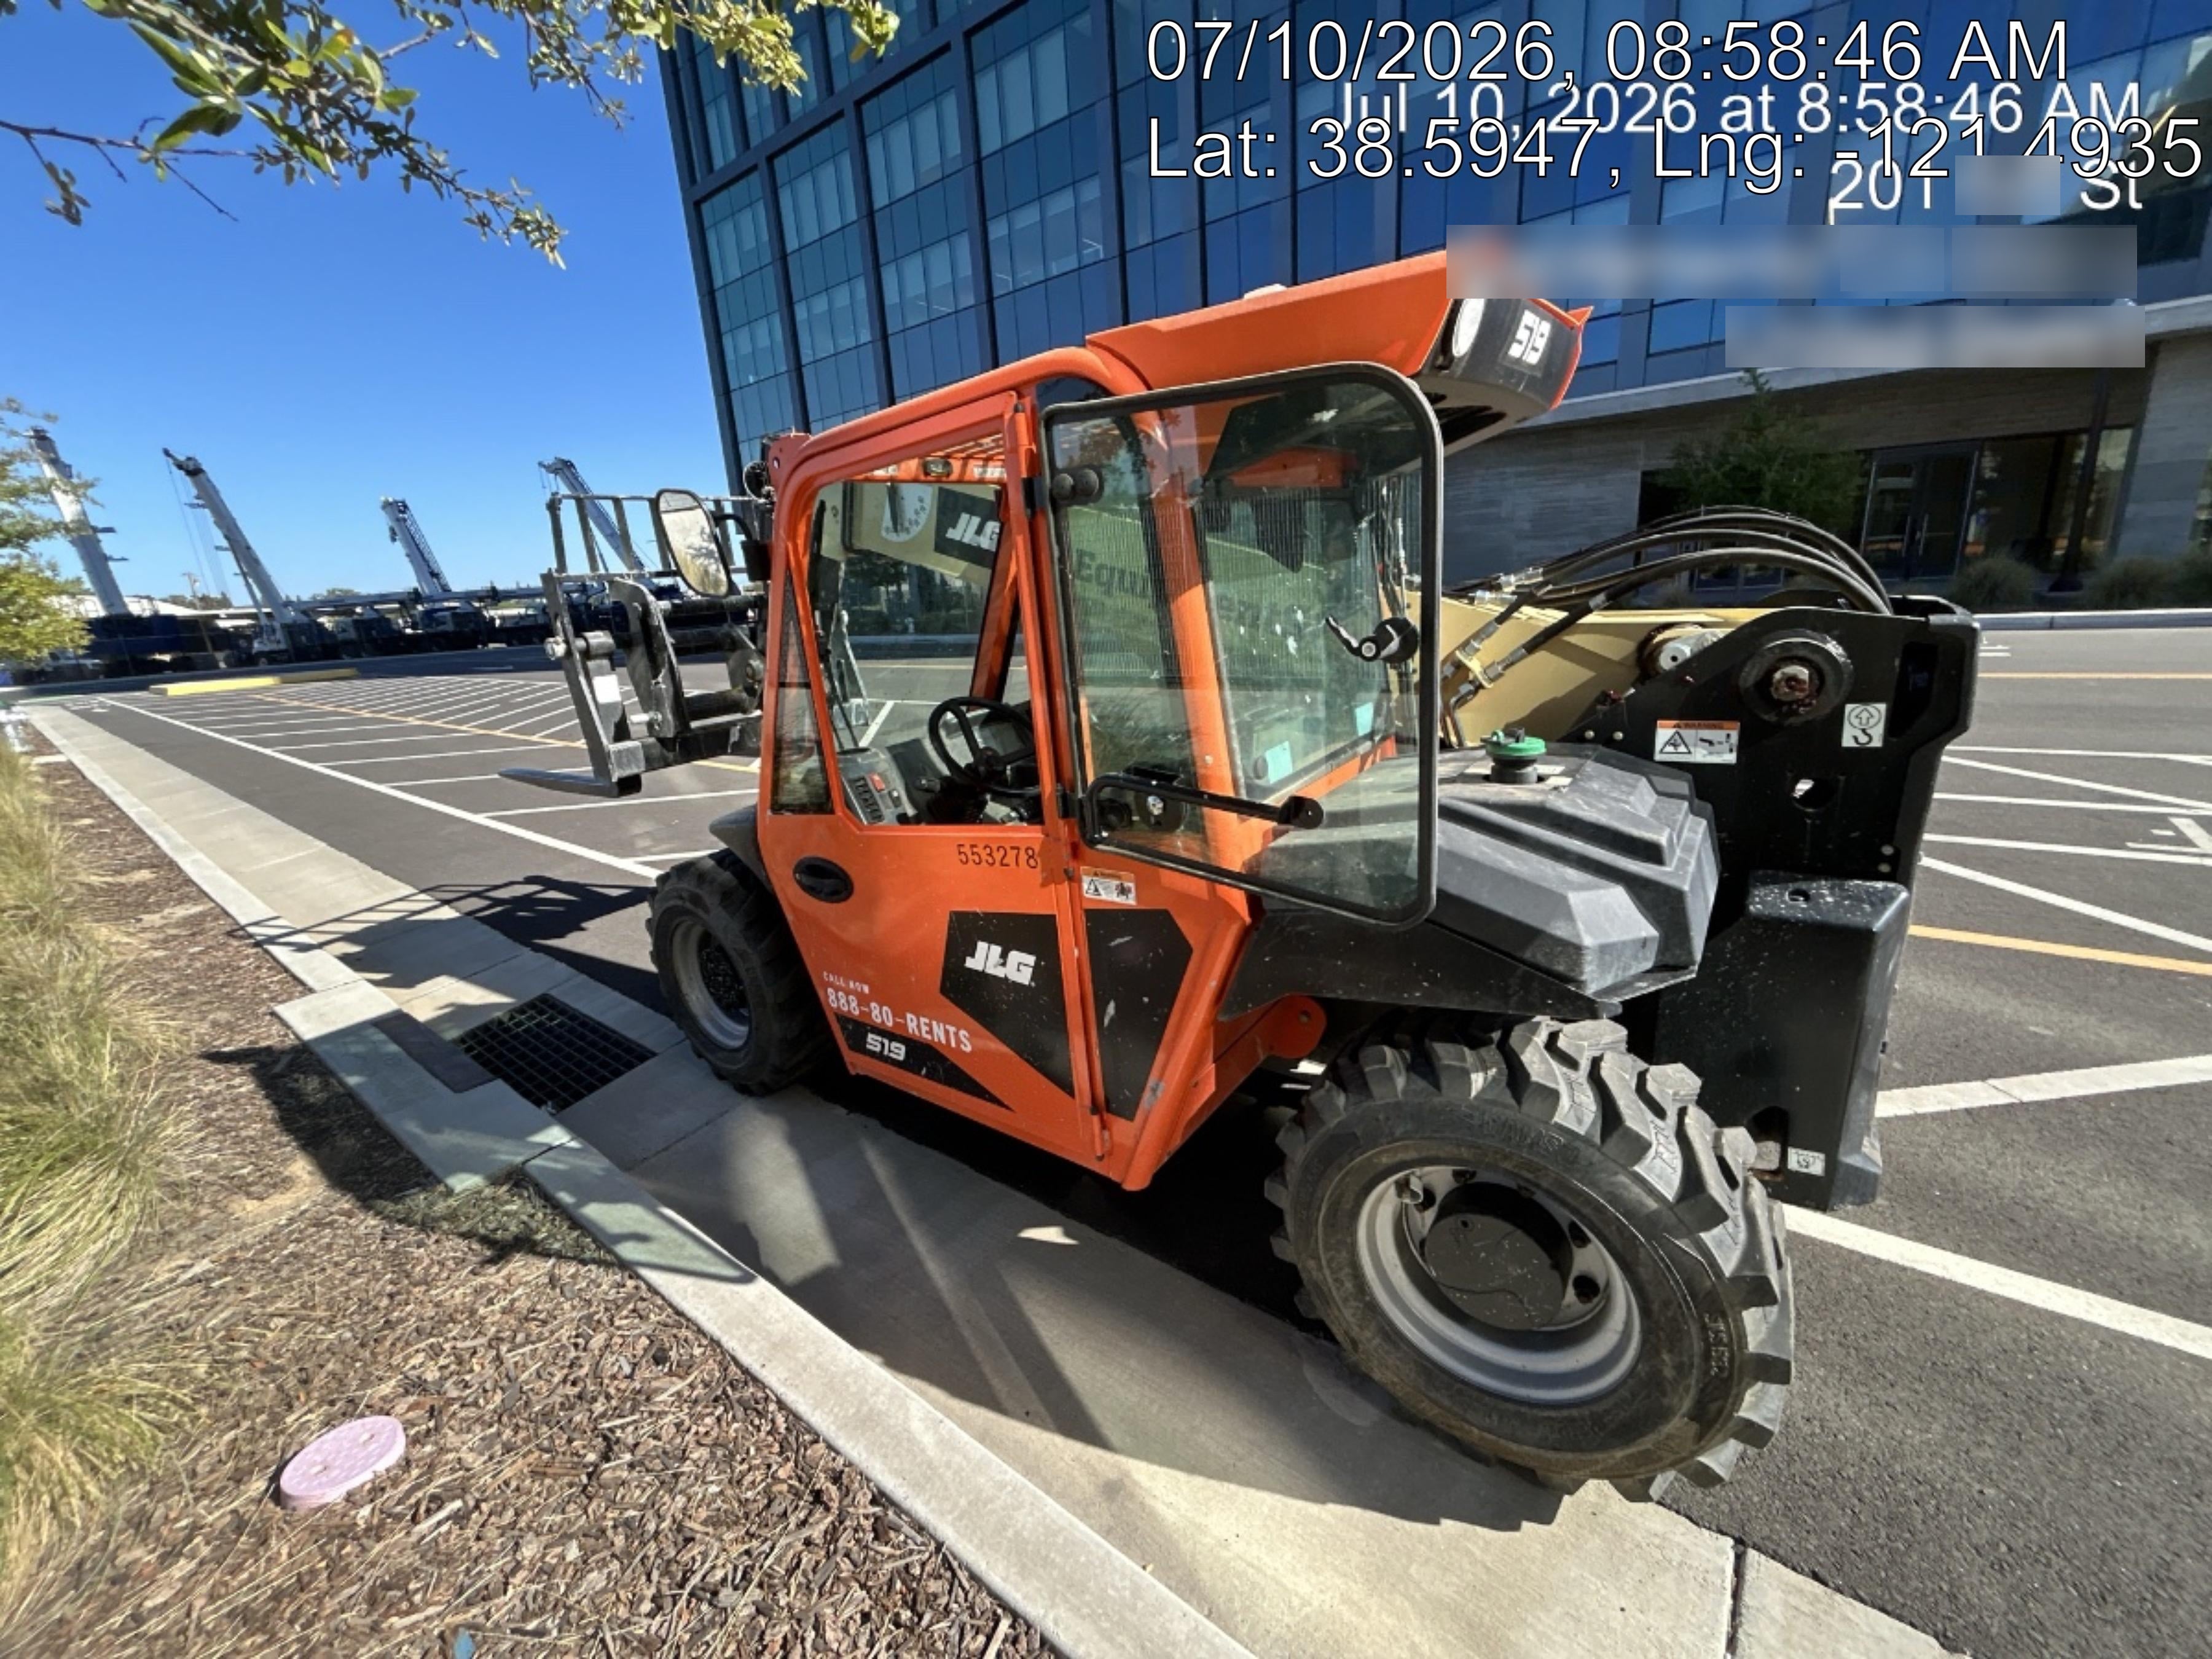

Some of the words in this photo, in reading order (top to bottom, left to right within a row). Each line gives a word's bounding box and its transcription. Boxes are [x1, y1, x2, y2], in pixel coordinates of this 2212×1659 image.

[945, 512, 1001, 552] JLG
[956, 844, 1038, 869] 553278
[823, 971, 845, 987] CALL
[963, 940, 1037, 986] JLG
[827, 987, 973, 1053] 888-80-RENTS
[866, 1032, 906, 1061] 519
